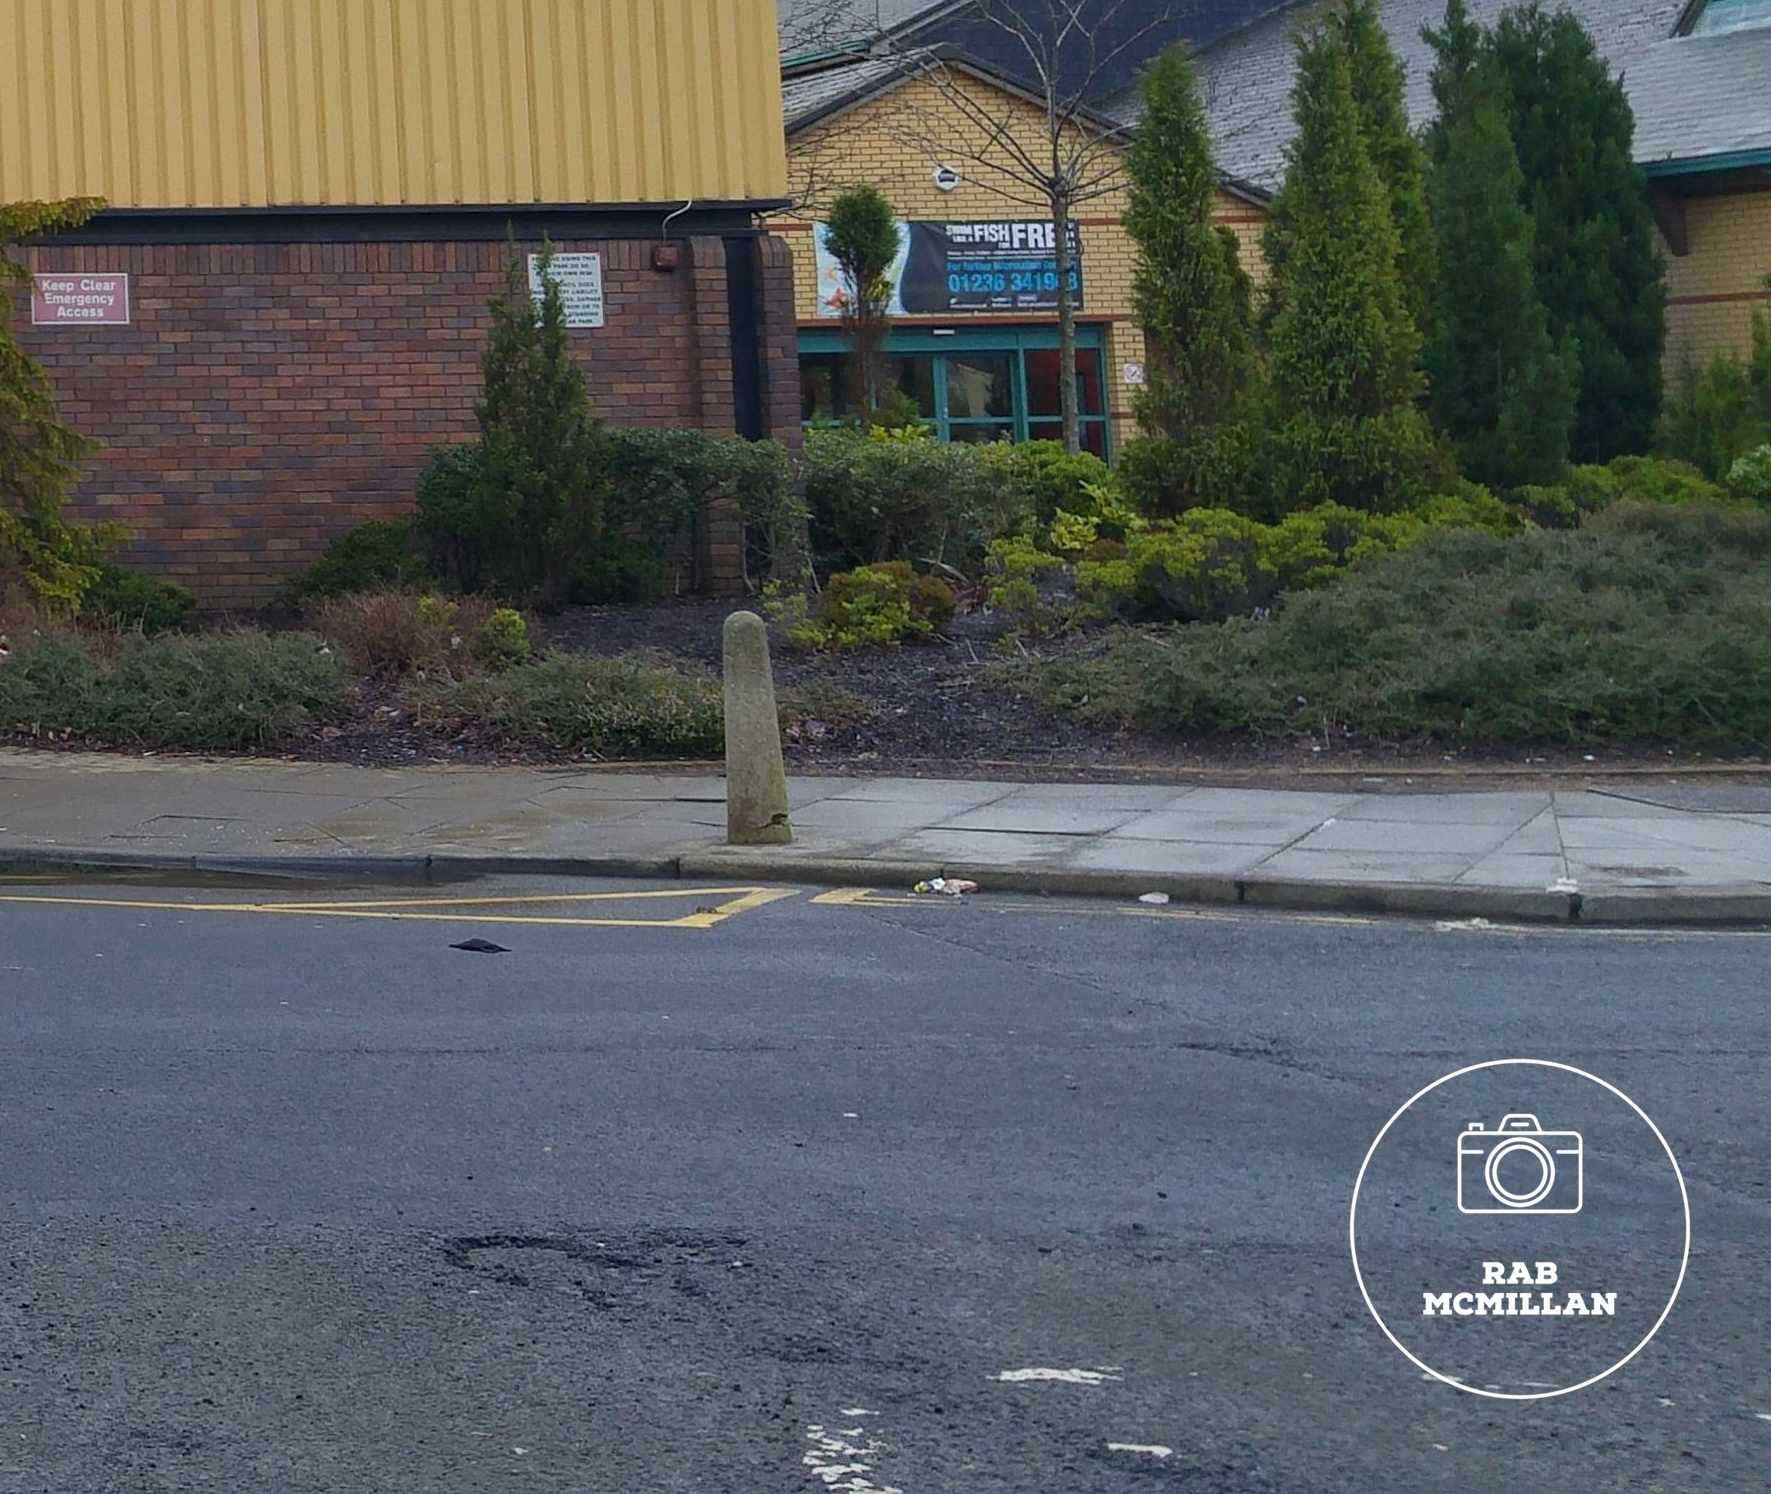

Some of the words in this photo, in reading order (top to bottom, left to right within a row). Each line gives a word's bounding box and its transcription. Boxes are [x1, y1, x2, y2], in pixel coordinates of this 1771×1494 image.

[974, 224, 1011, 242] FISH
[42, 280, 74, 293] Keep
[80, 279, 116, 291] Clear
[948, 273, 1005, 292] 01236
[1010, 272, 1079, 292] 34198
[44, 293, 115, 306] Emergency
[56, 306, 104, 318] Access
